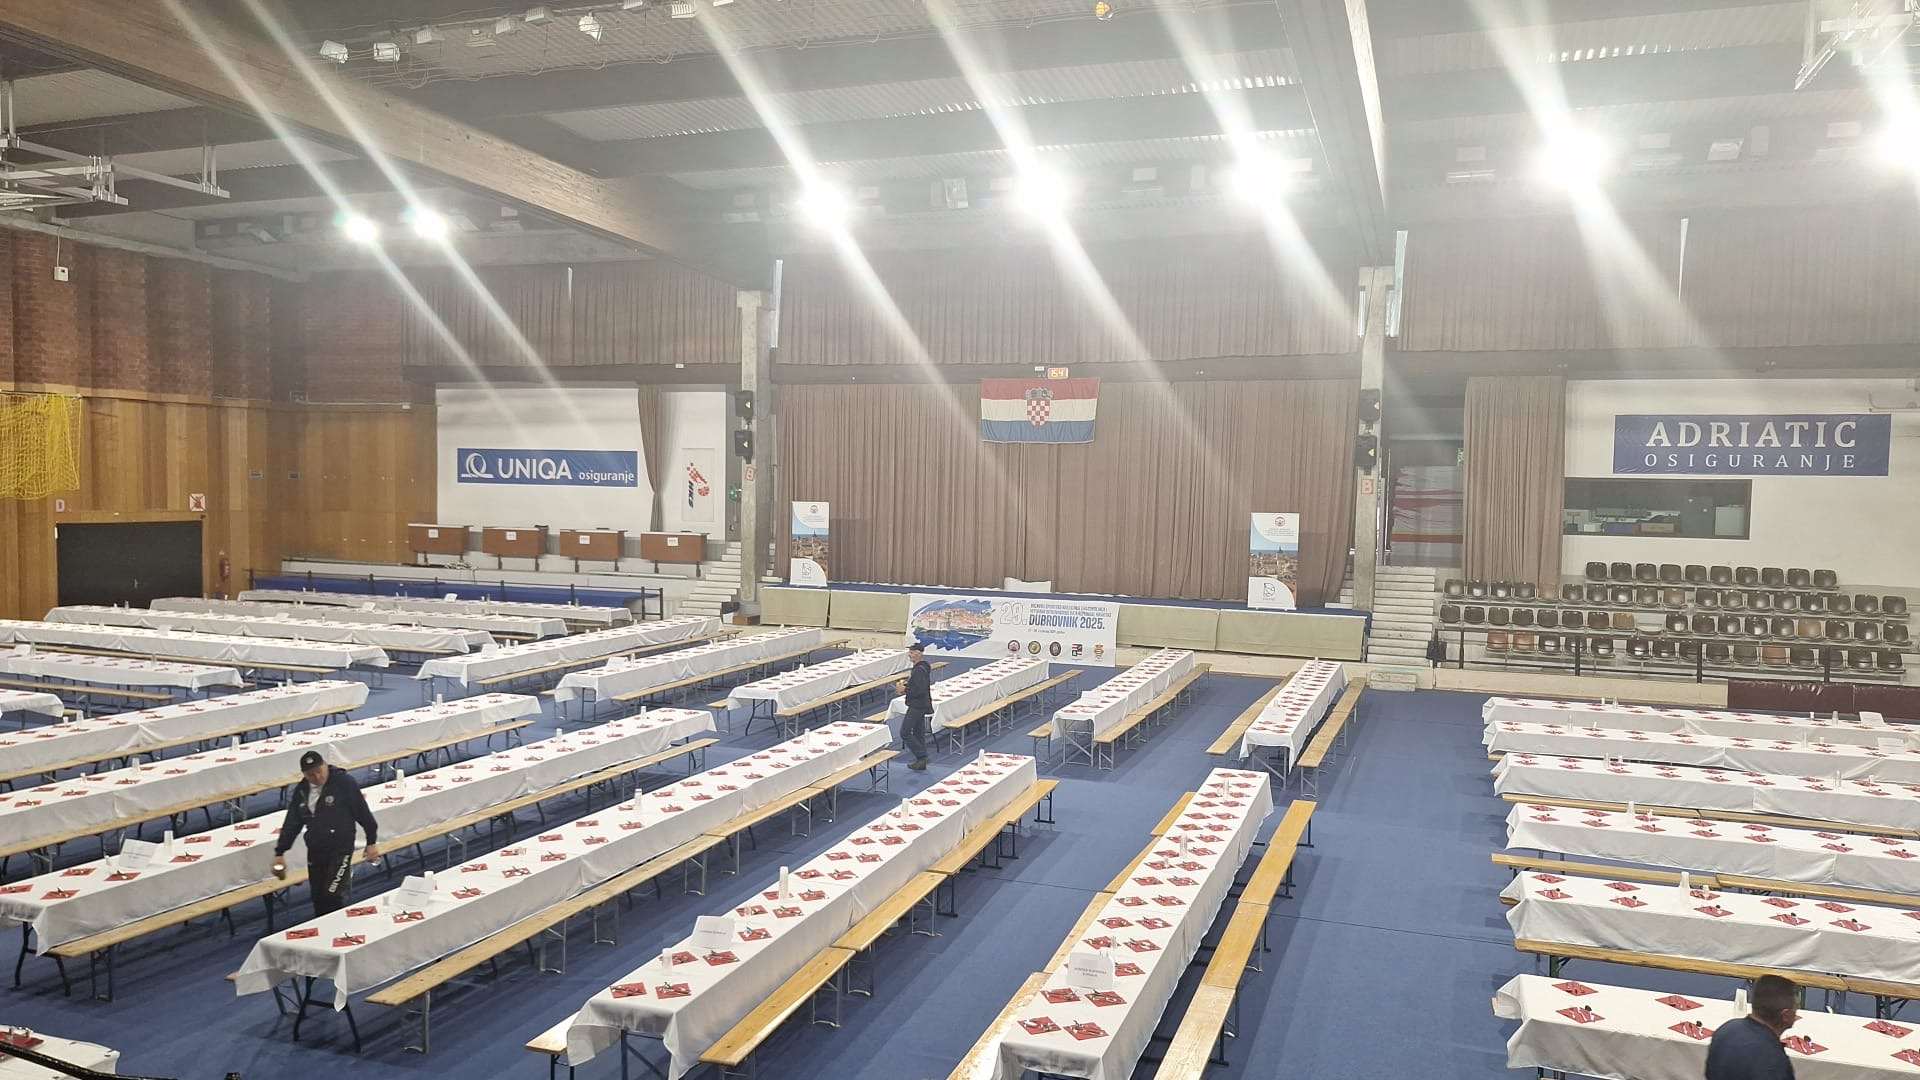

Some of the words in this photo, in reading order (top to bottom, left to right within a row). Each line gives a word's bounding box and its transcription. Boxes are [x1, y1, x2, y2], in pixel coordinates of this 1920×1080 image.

[1645, 421, 1857, 448] ADRIATIC
[497, 457, 573, 480] UNIQA
[578, 469, 635, 484] osiguranje
[1644, 453, 1856, 471] OSIGURANJE
[1028, 613, 1079, 628] DUBROVNIK
[1079, 616, 1105, 630] 2025.
